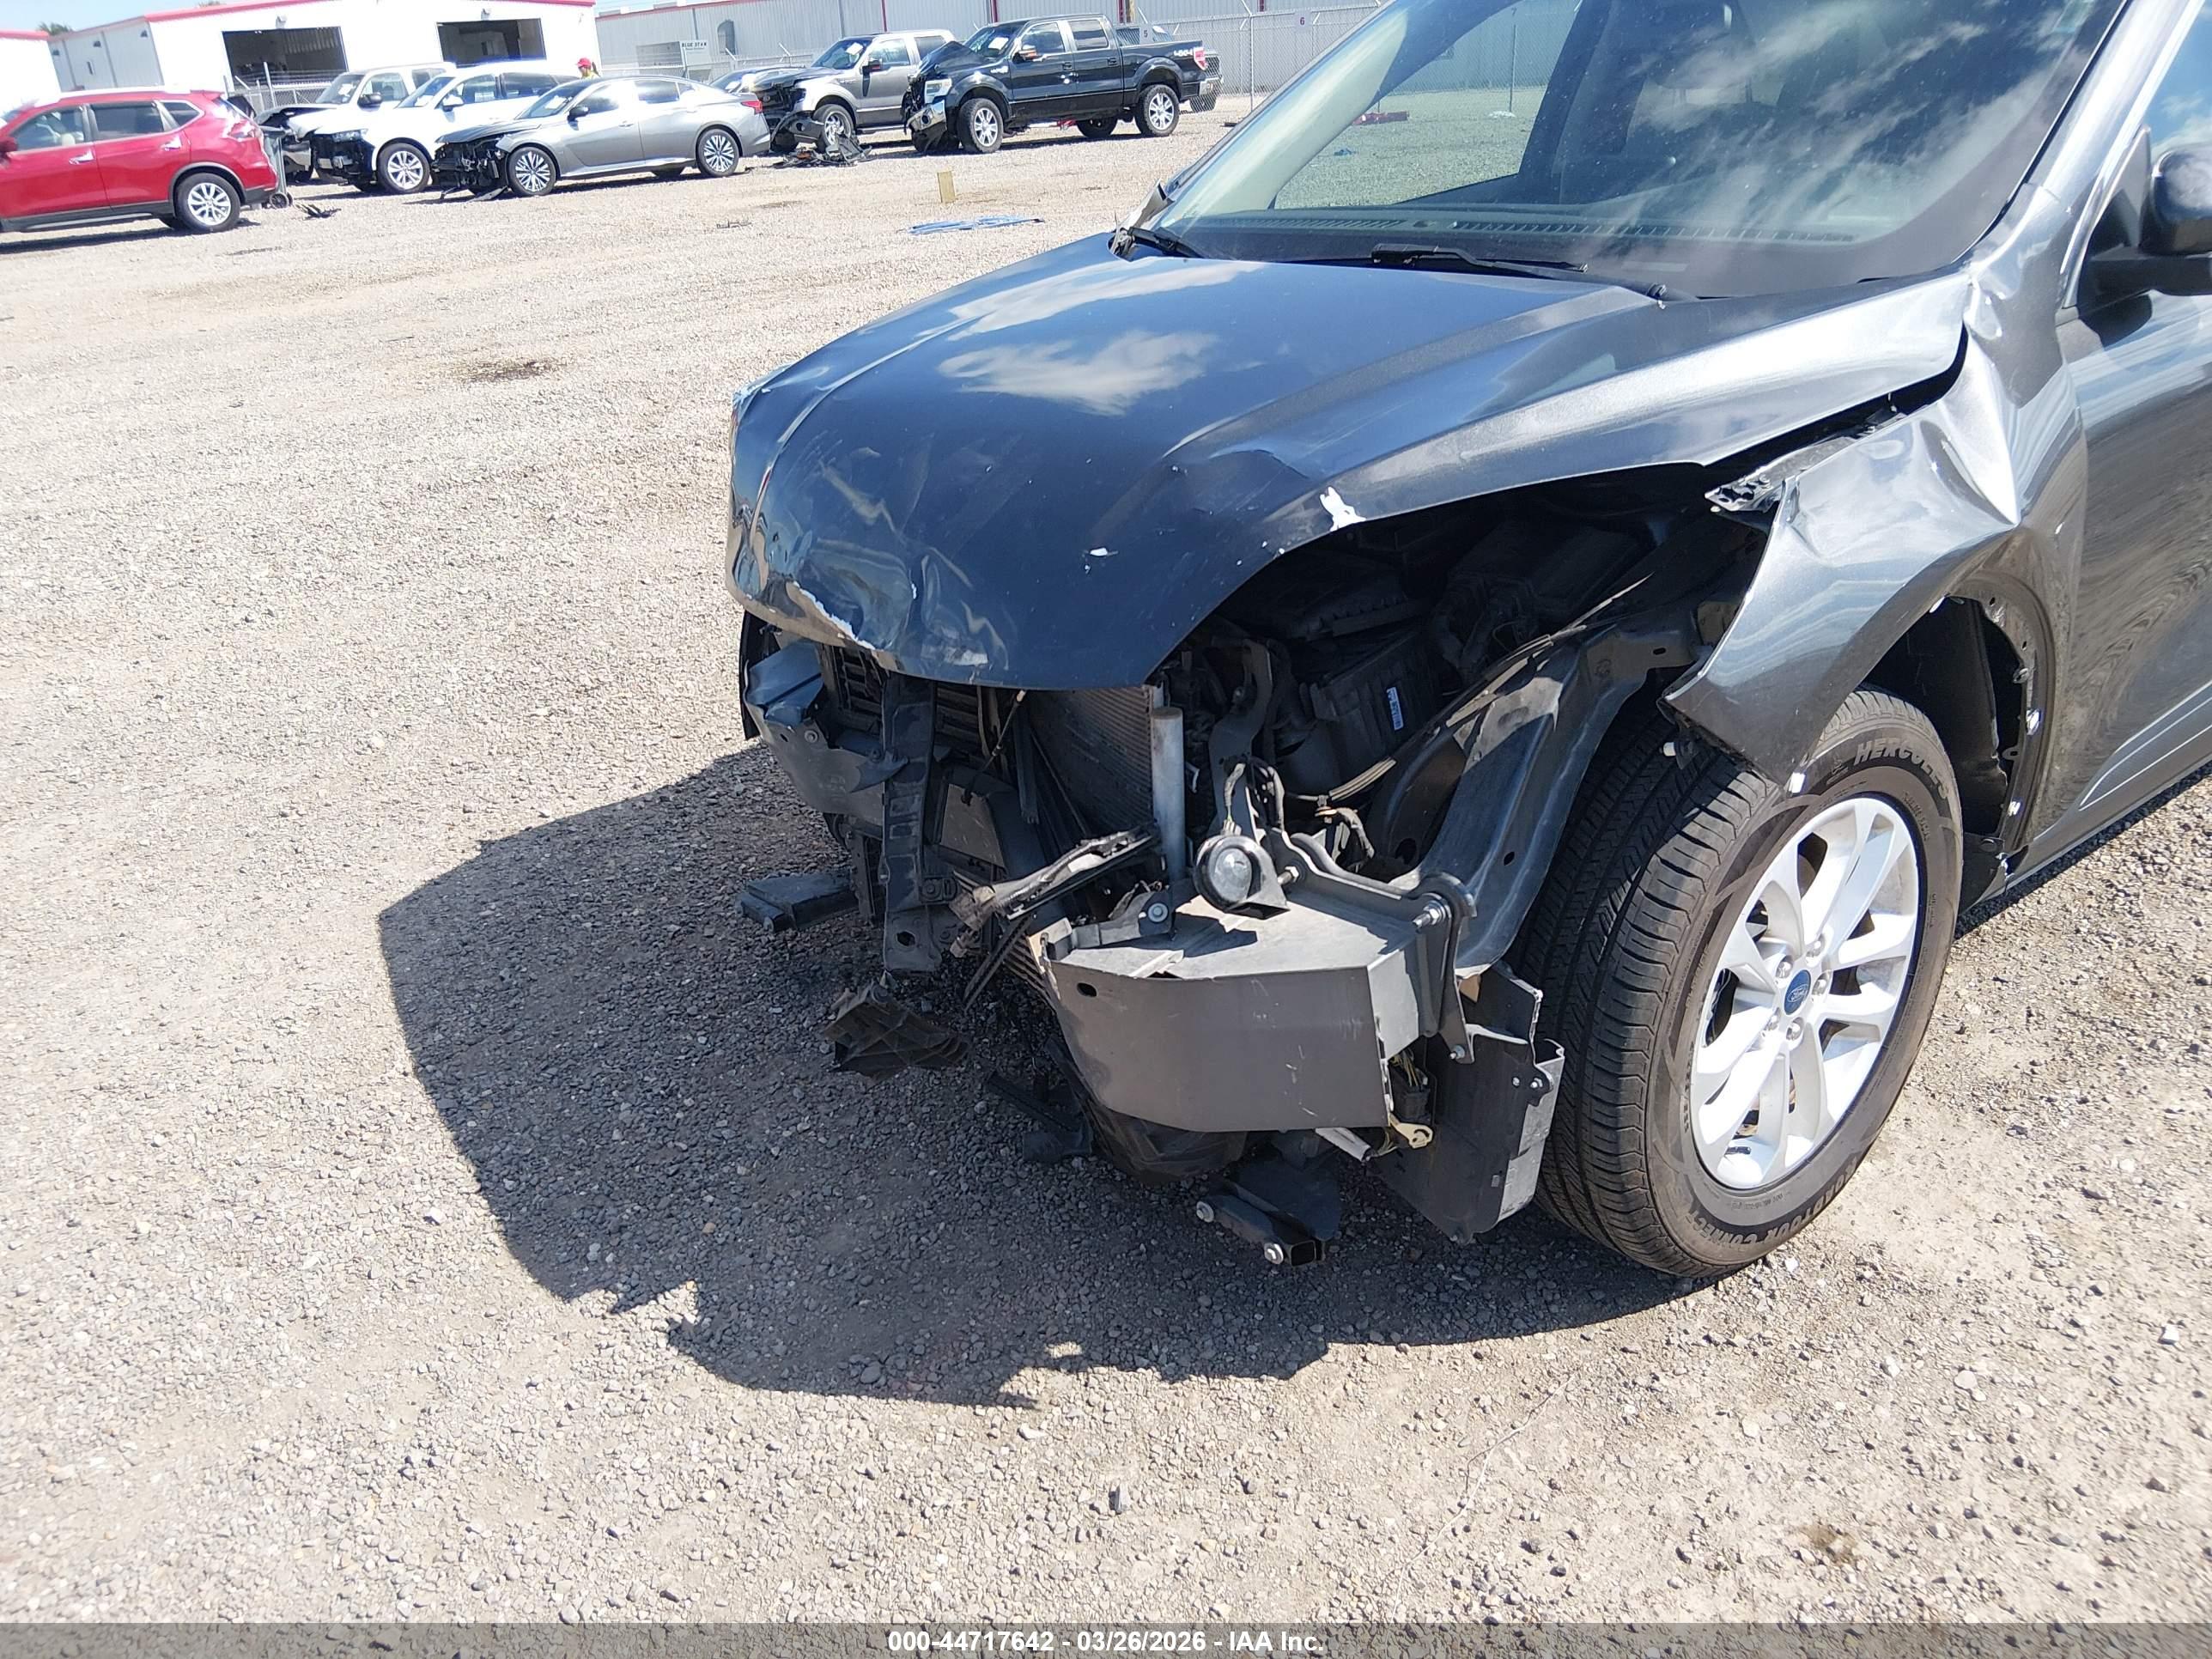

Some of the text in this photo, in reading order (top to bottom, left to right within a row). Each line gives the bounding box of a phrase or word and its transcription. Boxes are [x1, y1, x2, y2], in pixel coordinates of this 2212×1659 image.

[1300, 16, 1305, 26] 6
[1853, 737, 1949, 799] HERCULES
[1686, 1208, 1759, 1245] CONNECT
